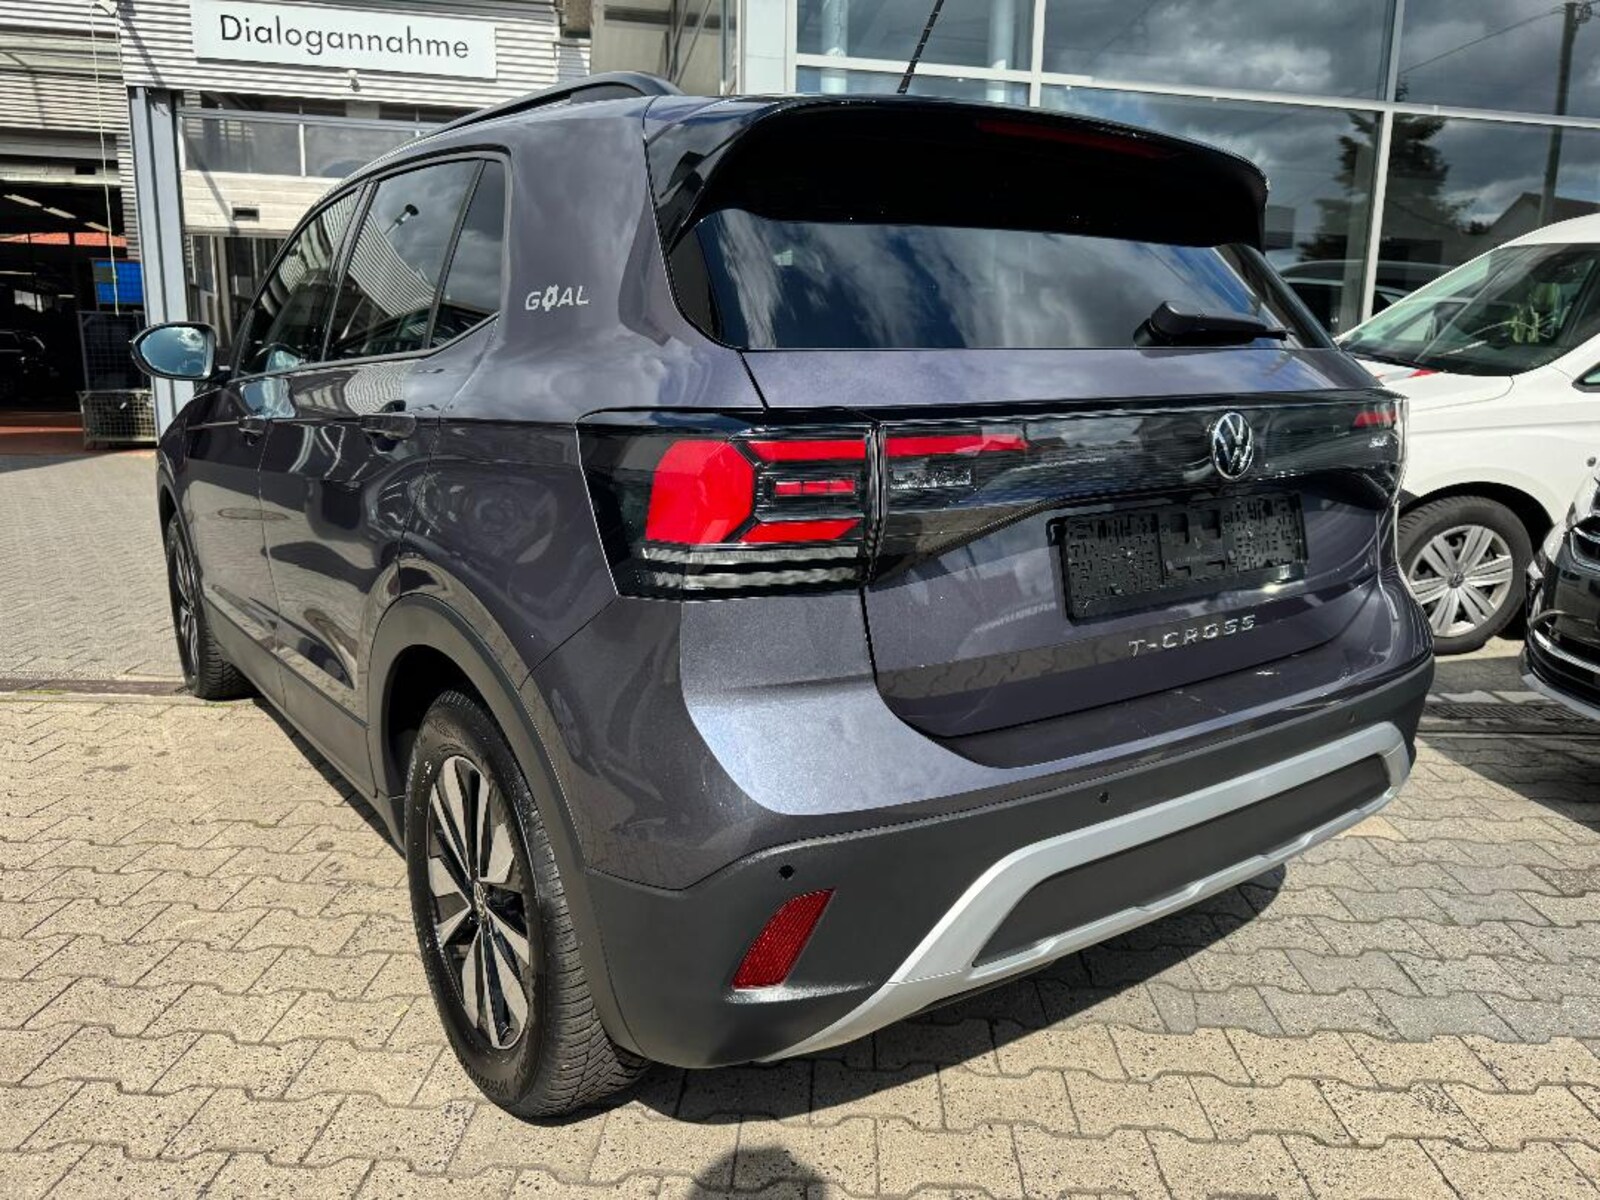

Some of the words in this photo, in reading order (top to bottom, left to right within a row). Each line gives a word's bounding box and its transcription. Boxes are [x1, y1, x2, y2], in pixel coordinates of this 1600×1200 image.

[220, 14, 470, 58] Dialogannahme
[525, 284, 590, 312] GOAL
[1128, 614, 1256, 657] T-CROSS
